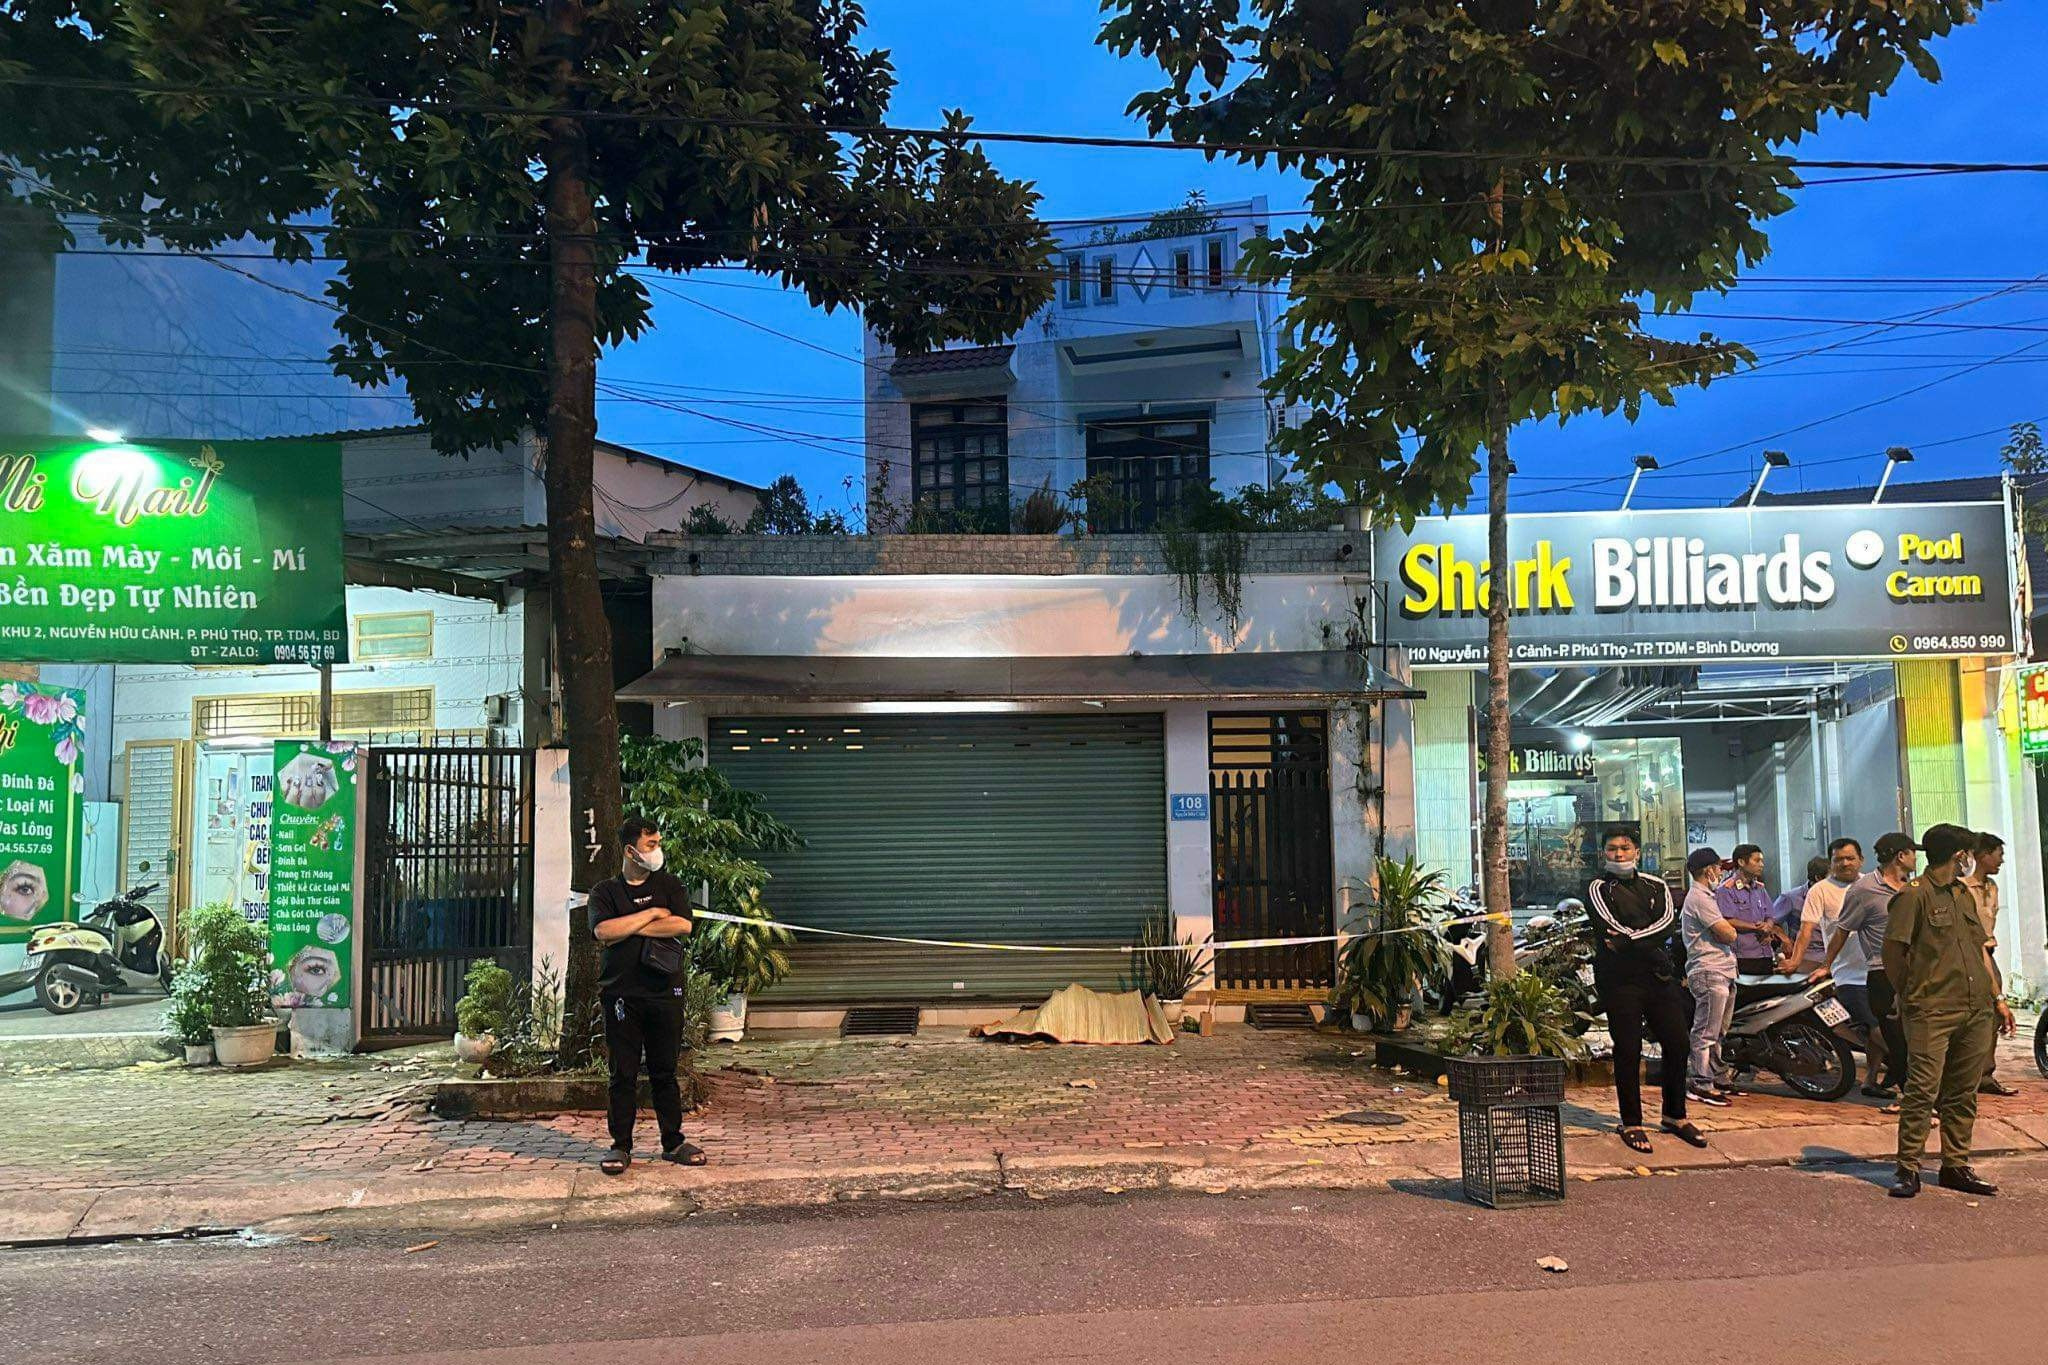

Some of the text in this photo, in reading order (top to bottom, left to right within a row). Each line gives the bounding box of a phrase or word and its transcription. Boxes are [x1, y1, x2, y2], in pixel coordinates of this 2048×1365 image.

[75, 464, 208, 525] Nail
[27, 541, 92, 567] Xăm
[102, 543, 161, 574] Mày
[192, 545, 243, 571] Môi
[273, 546, 306, 571] Mí
[1897, 532, 1962, 561] Pool
[1593, 533, 1835, 607] Billiards
[1886, 570, 1981, 597] Carom
[59, 583, 116, 613] Đẹp
[124, 585, 165, 614] Tự
[173, 584, 257, 609] Nhiên
[2, 626, 30, 638] KHU
[201, 627, 228, 641] PHÚ
[1913, 634, 2005, 650] 0964.850 990
[220, 646, 259, 658] ZALO:
[274, 645, 296, 660] 0904
[298, 645, 309, 661] 56
[311, 645, 321, 661] 57
[324, 646, 335, 661] 69
[1429, 643, 1480, 662] Nguyễn
[1571, 643, 1599, 657] Phú
[1730, 640, 1779, 655] Dương
[1524, 748, 1593, 773] Billiards
[2, 773, 55, 791] Đính Đá
[6, 797, 35, 816] Loại
[1178, 796, 1202, 809] 108
[22, 820, 53, 840] Lông
